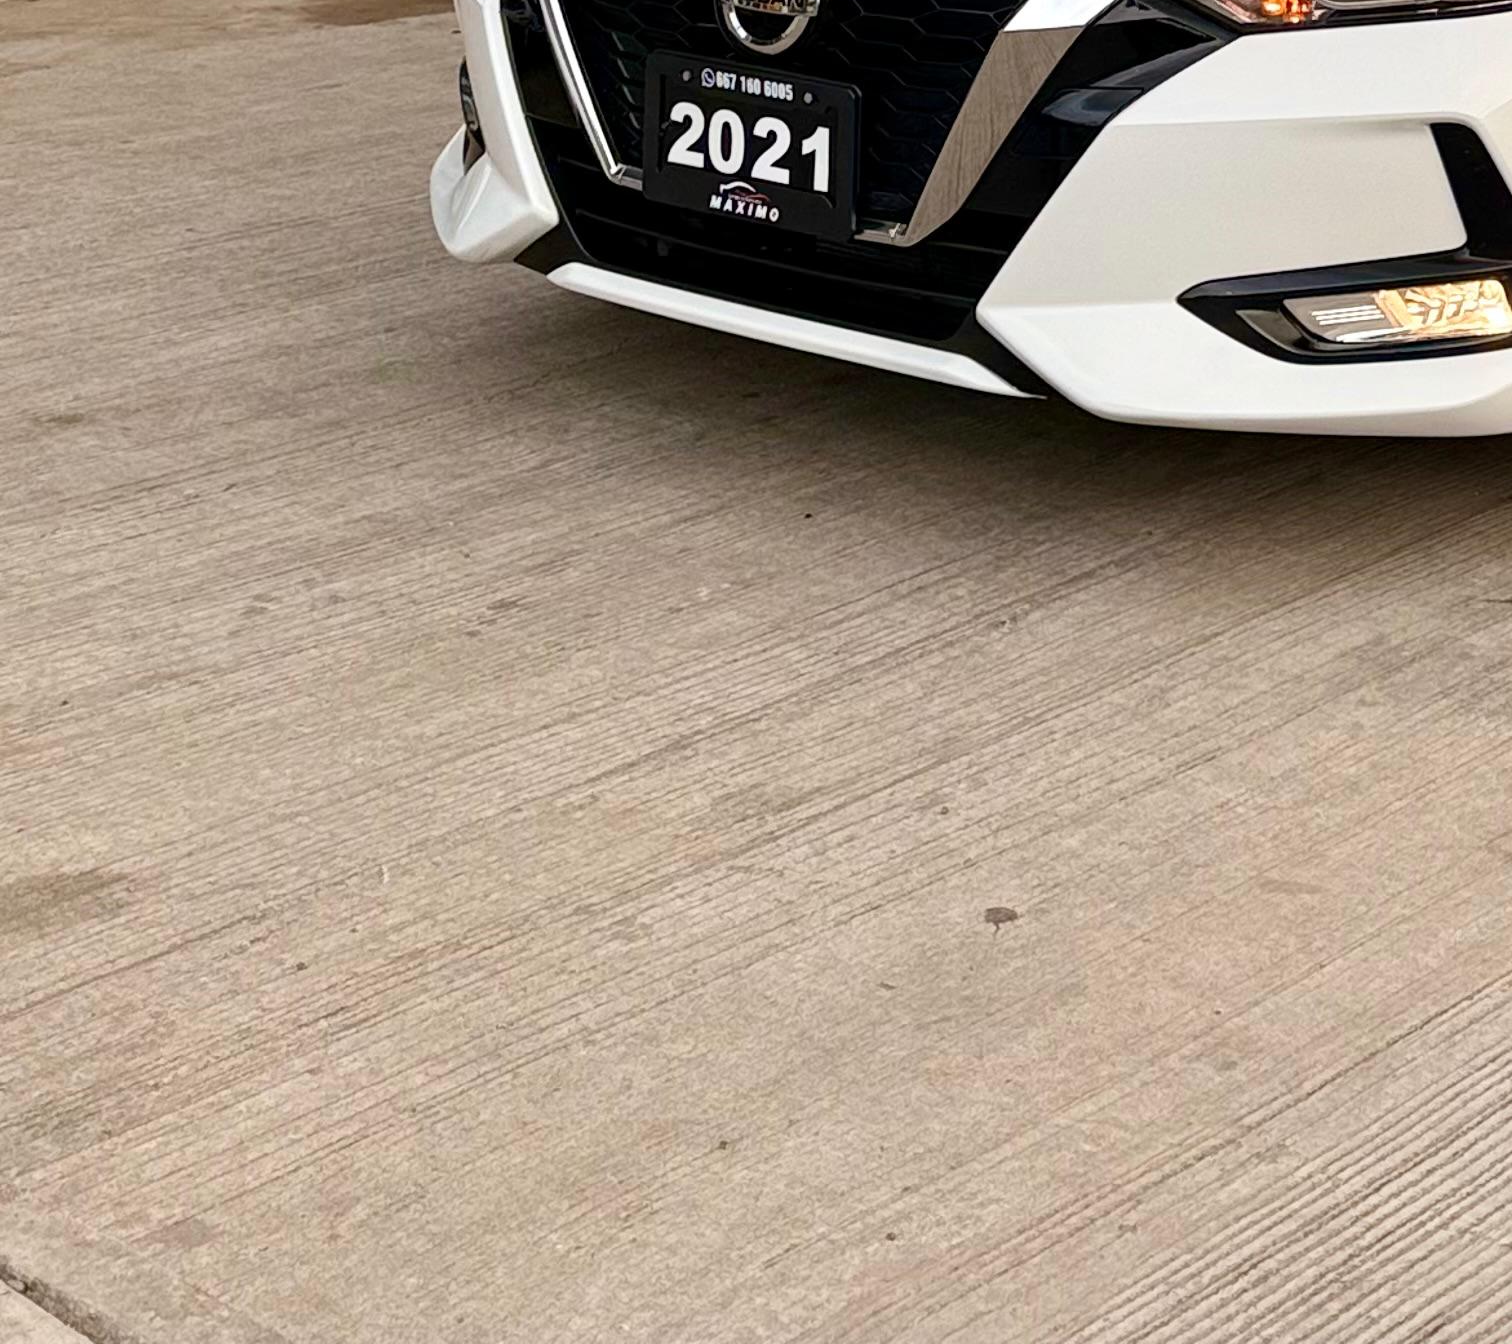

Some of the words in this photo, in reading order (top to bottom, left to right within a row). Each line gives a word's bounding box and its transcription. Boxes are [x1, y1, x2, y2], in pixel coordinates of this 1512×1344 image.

[716, 71, 737, 91] 667
[763, 80, 794, 102] 6005
[667, 101, 830, 193] 2021
[709, 194, 780, 223] MAXIMO
